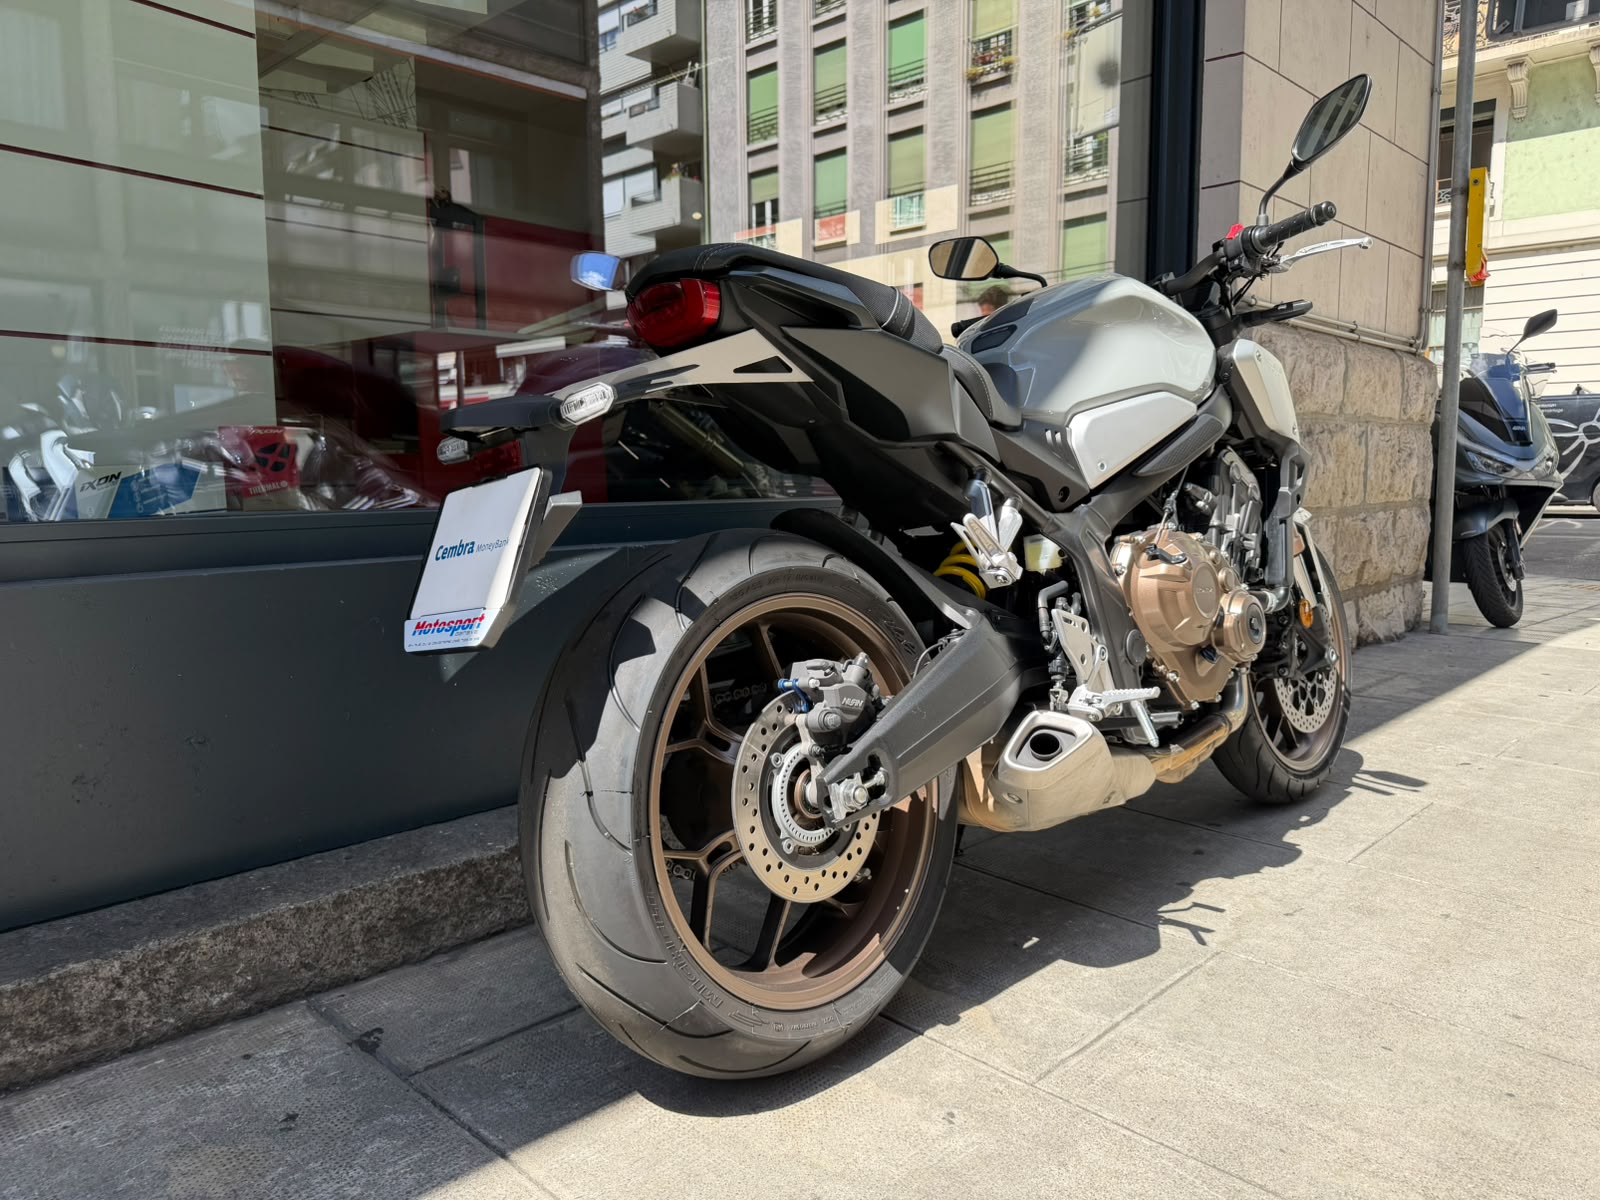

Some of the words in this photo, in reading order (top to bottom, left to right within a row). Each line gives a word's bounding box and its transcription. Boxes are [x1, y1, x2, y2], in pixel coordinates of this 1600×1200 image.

[249, 482, 281, 495] THERMAL
[435, 539, 475, 561] Cembra
[476, 537, 509, 552] MoneyBank
[412, 614, 485, 636] Motosport
